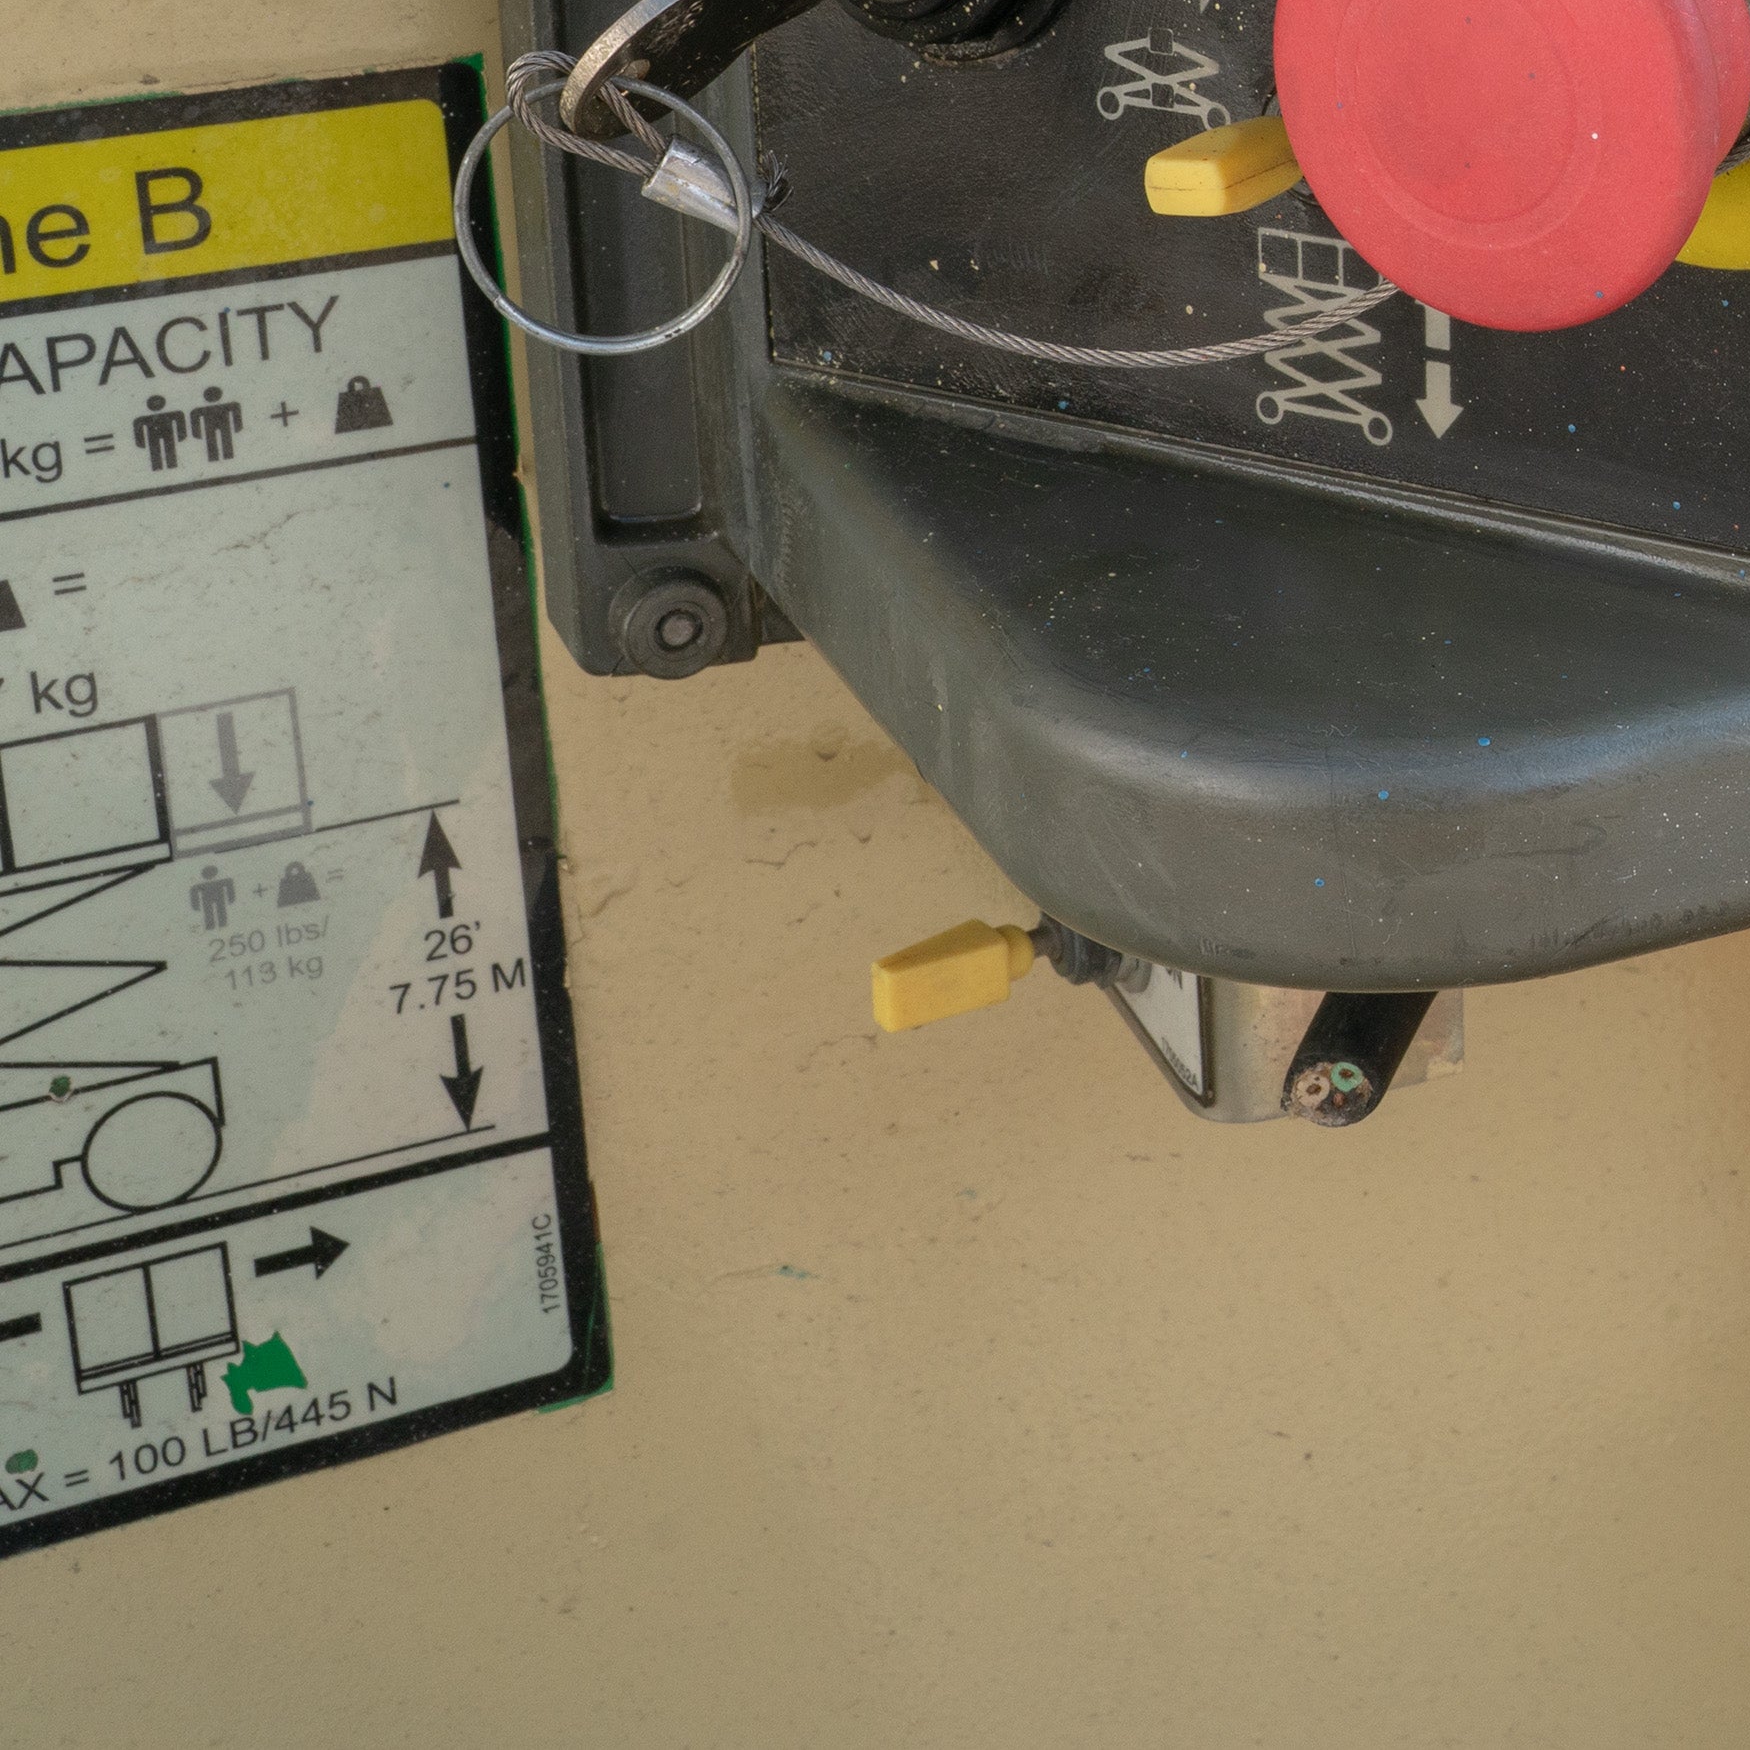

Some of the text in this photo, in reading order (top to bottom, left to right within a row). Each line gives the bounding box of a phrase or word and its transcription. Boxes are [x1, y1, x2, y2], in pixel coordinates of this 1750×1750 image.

[134, 166, 213, 255] B
[0, 294, 340, 396] APACITY
[0, 437, 63, 484] kg
[30, 670, 98, 718] kg
[209, 914, 331, 963] 250 lbs/
[225, 954, 324, 990] 113 kg
[389, 957, 527, 1015] 7.75 M
[531, 1212, 561, 1314] 1705941C
[109, 1436, 187, 1481] 100
[203, 1389, 352, 1457] LB/445
[366, 1376, 398, 1412] N
